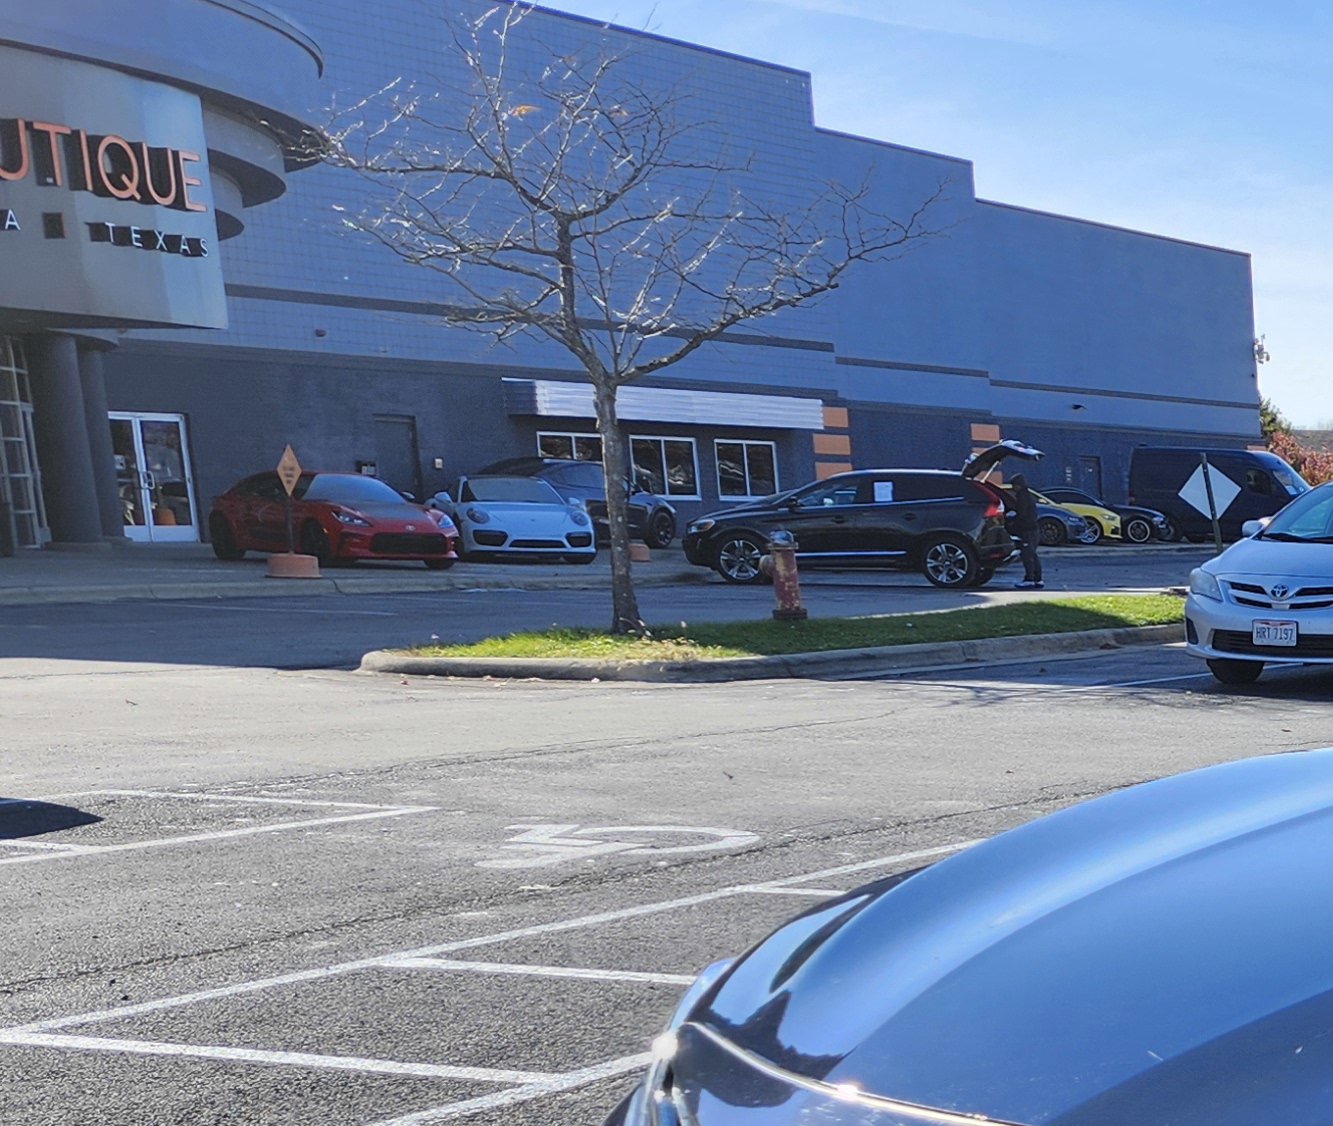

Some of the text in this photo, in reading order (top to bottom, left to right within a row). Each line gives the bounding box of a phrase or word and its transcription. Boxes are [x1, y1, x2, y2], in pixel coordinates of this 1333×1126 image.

[105, 221, 209, 258] TEXAS
[1255, 626, 1294, 641] HRT 7197
